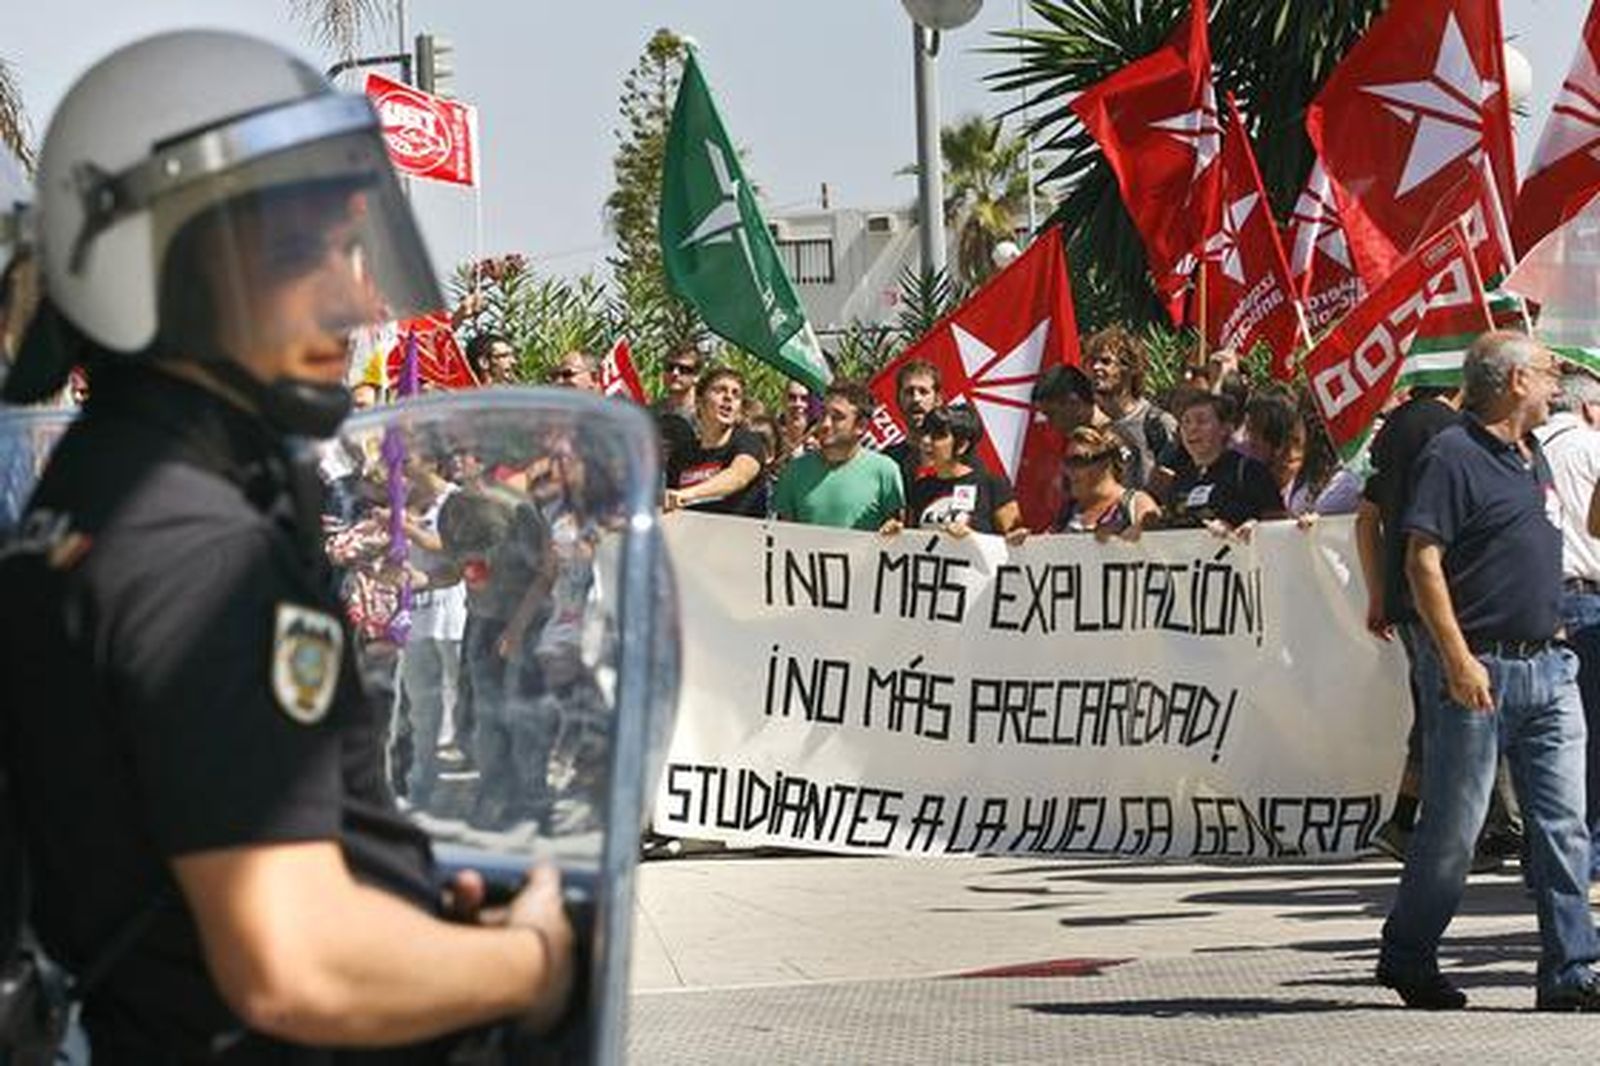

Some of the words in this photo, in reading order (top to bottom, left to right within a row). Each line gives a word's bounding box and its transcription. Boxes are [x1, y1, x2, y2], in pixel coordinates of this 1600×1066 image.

[765, 534, 849, 610] ¡NO
[873, 534, 970, 623] MÁS
[764, 644, 850, 725] ¡NO
[863, 654, 955, 741] MÁS
[905, 794, 945, 853] A
[943, 796, 1007, 853] LA
[1007, 796, 1173, 856] HUELGA
